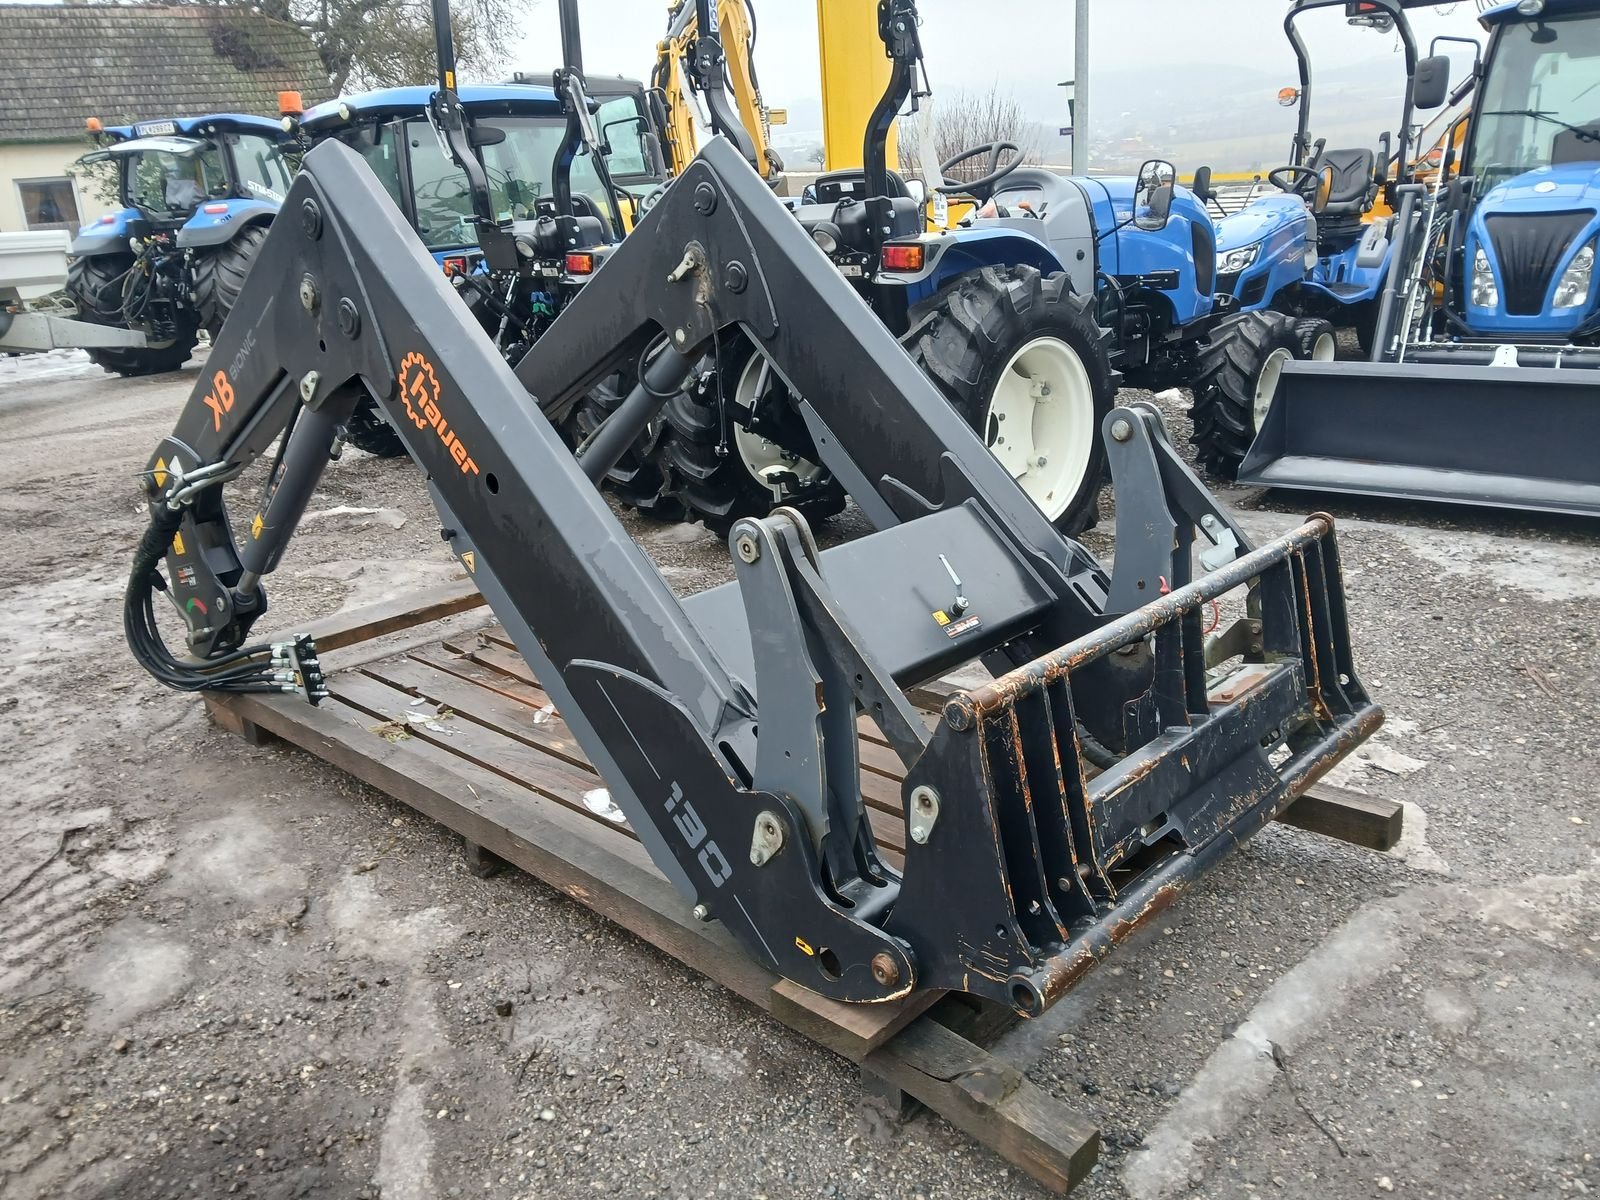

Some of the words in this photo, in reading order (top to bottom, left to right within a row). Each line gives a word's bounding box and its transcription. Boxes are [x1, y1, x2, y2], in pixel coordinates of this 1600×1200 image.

[203, 370, 235, 433] XB
[229, 329, 256, 380] BIONIC
[409, 370, 480, 475] hauer
[663, 780, 733, 889] 130
